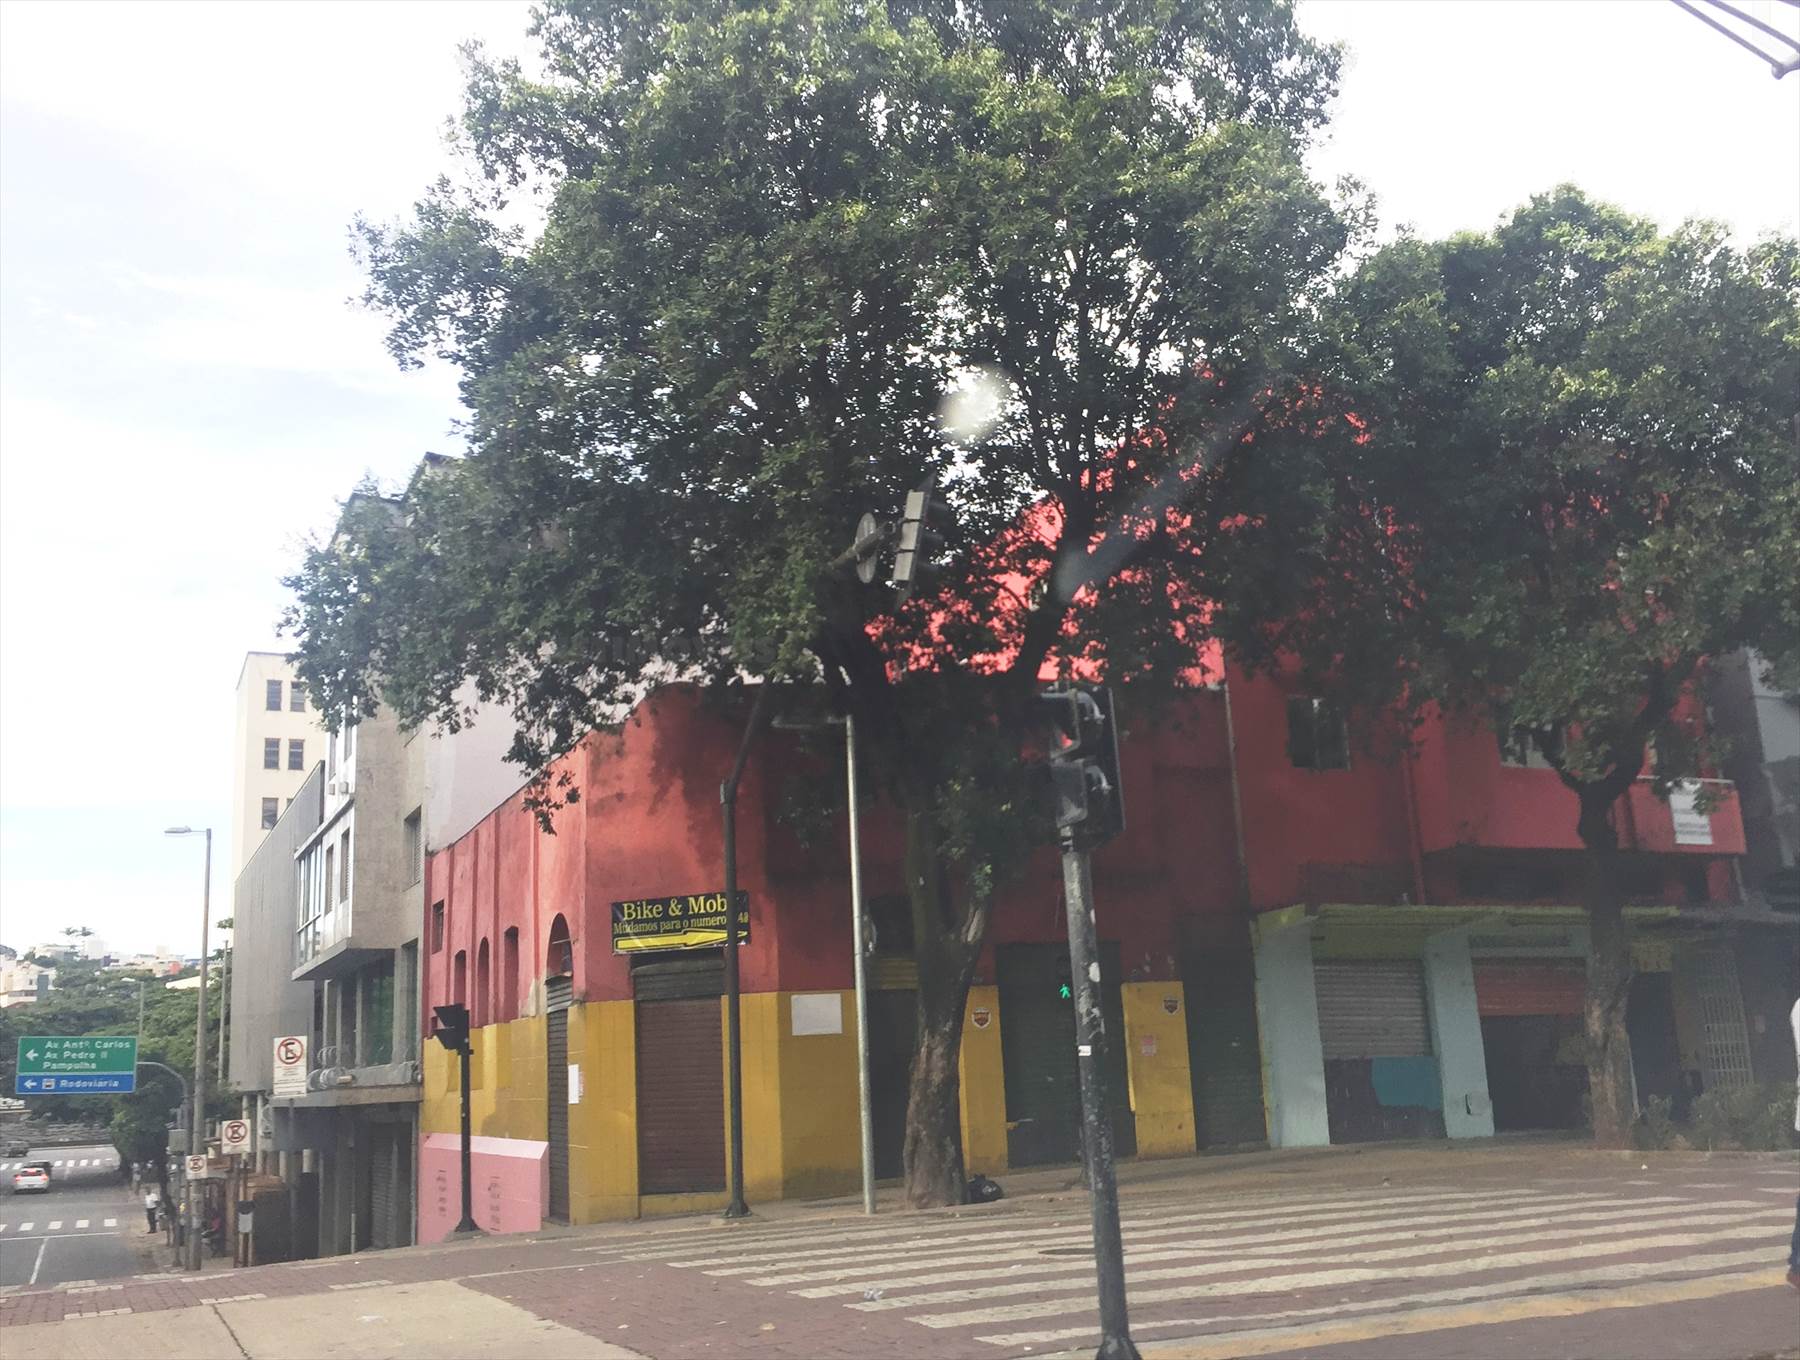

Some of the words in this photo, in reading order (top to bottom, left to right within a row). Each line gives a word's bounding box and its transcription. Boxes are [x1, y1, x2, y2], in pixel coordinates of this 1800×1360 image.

[622, 901, 663, 921] Bike
[668, 898, 682, 916] &
[613, 921, 658, 934] Mudamos
[660, 920, 681, 932] para
[683, 920, 689, 928] o
[95, 1041, 131, 1049] Carlos
[63, 1051, 97, 1059] Pedro
[42, 1061, 97, 1071] Pampulha
